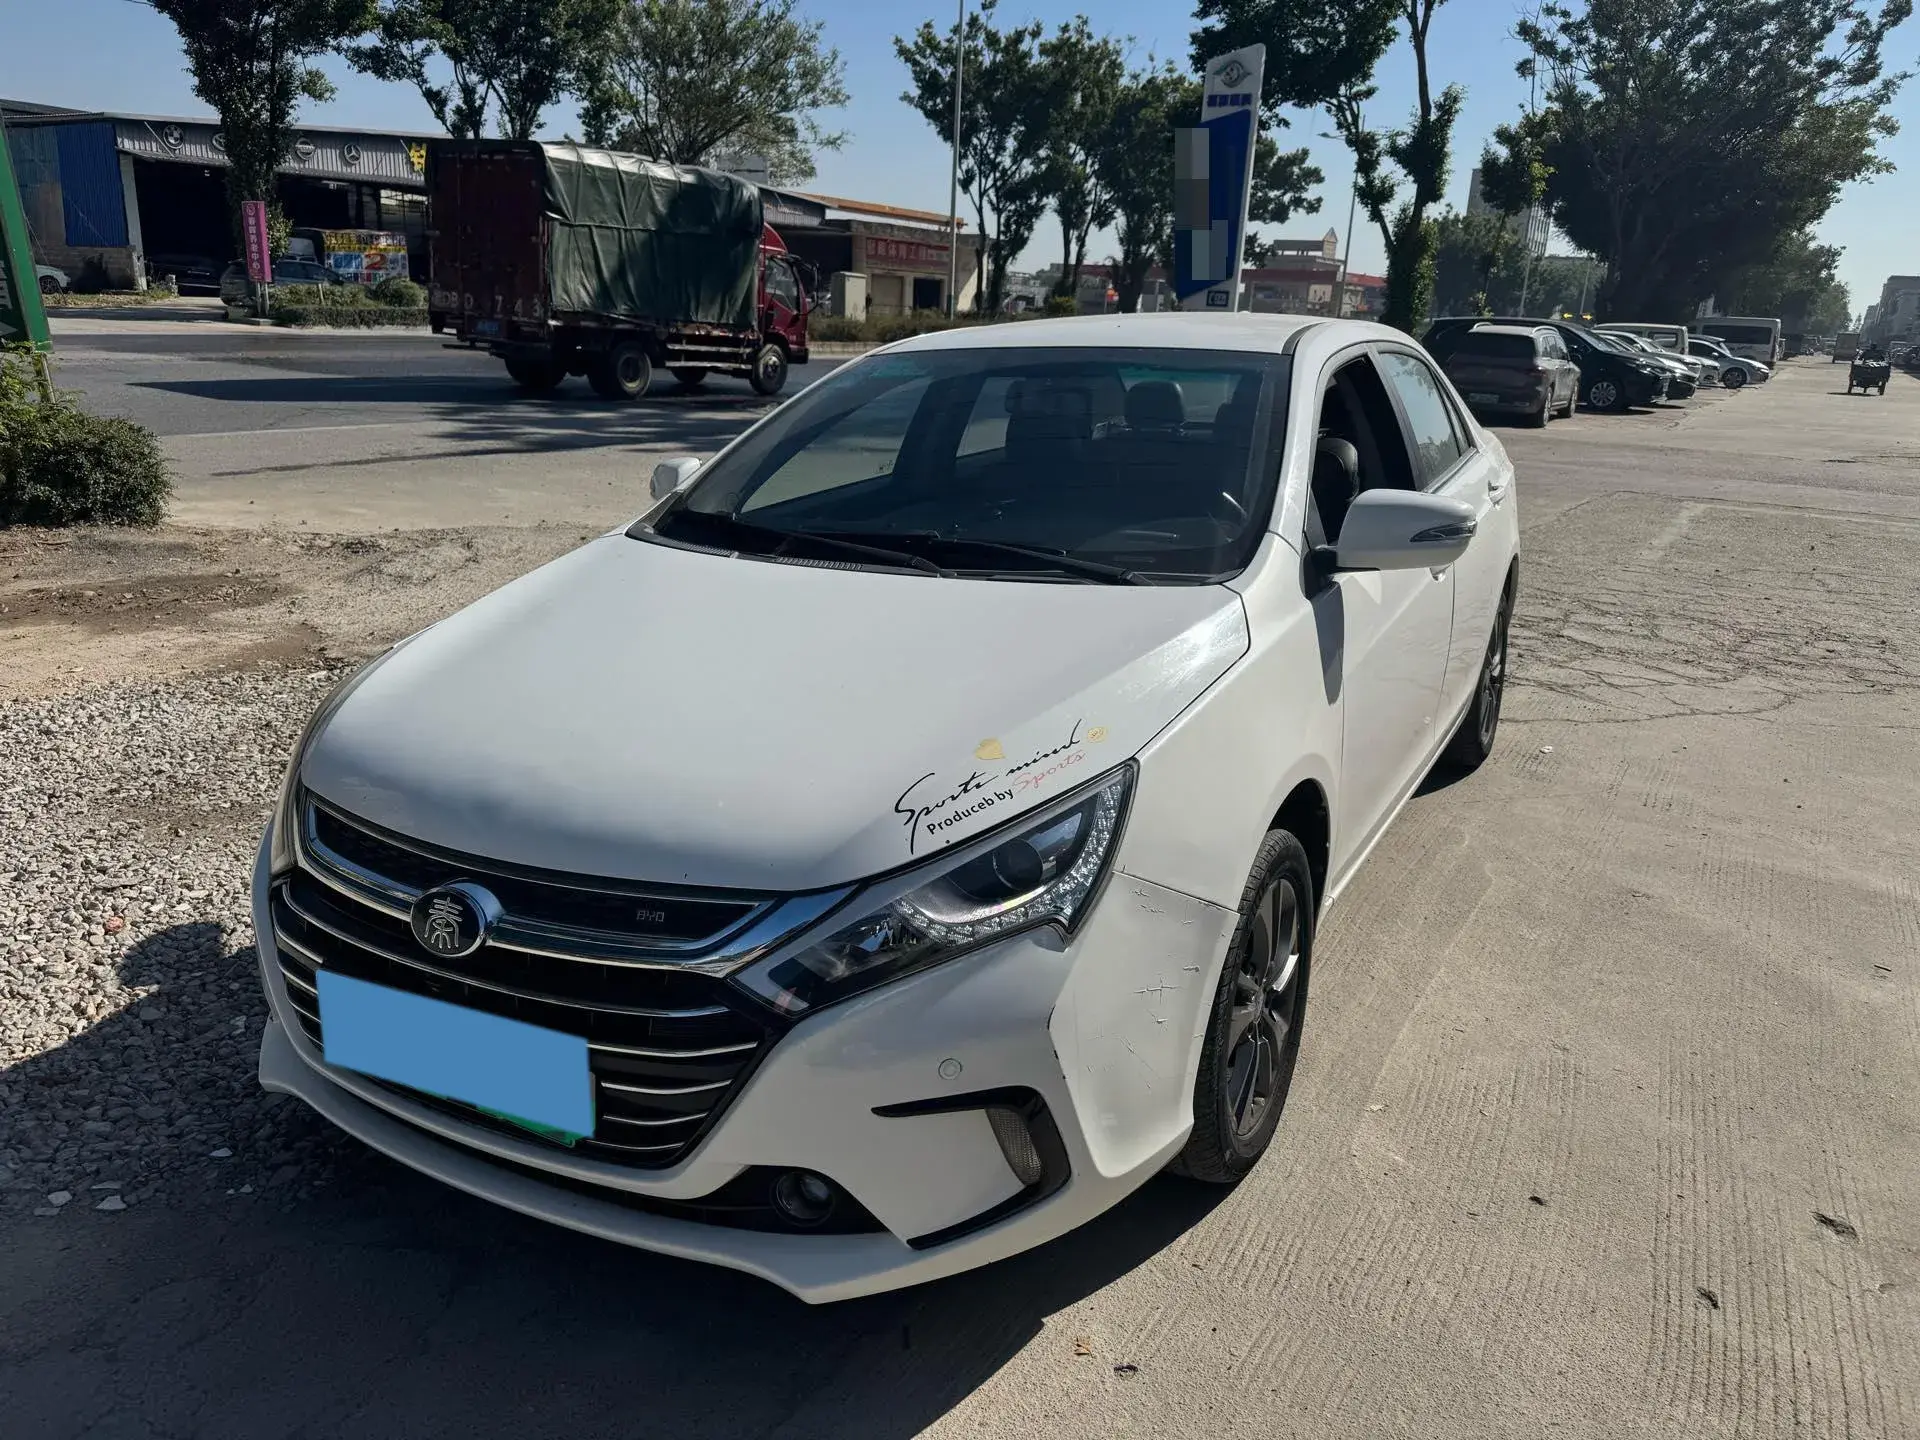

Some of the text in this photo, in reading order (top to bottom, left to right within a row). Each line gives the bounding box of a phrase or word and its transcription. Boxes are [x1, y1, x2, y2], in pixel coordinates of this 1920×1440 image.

[926, 749, 1086, 835] Produceb by Sports
[635, 908, 666, 923] BYD
